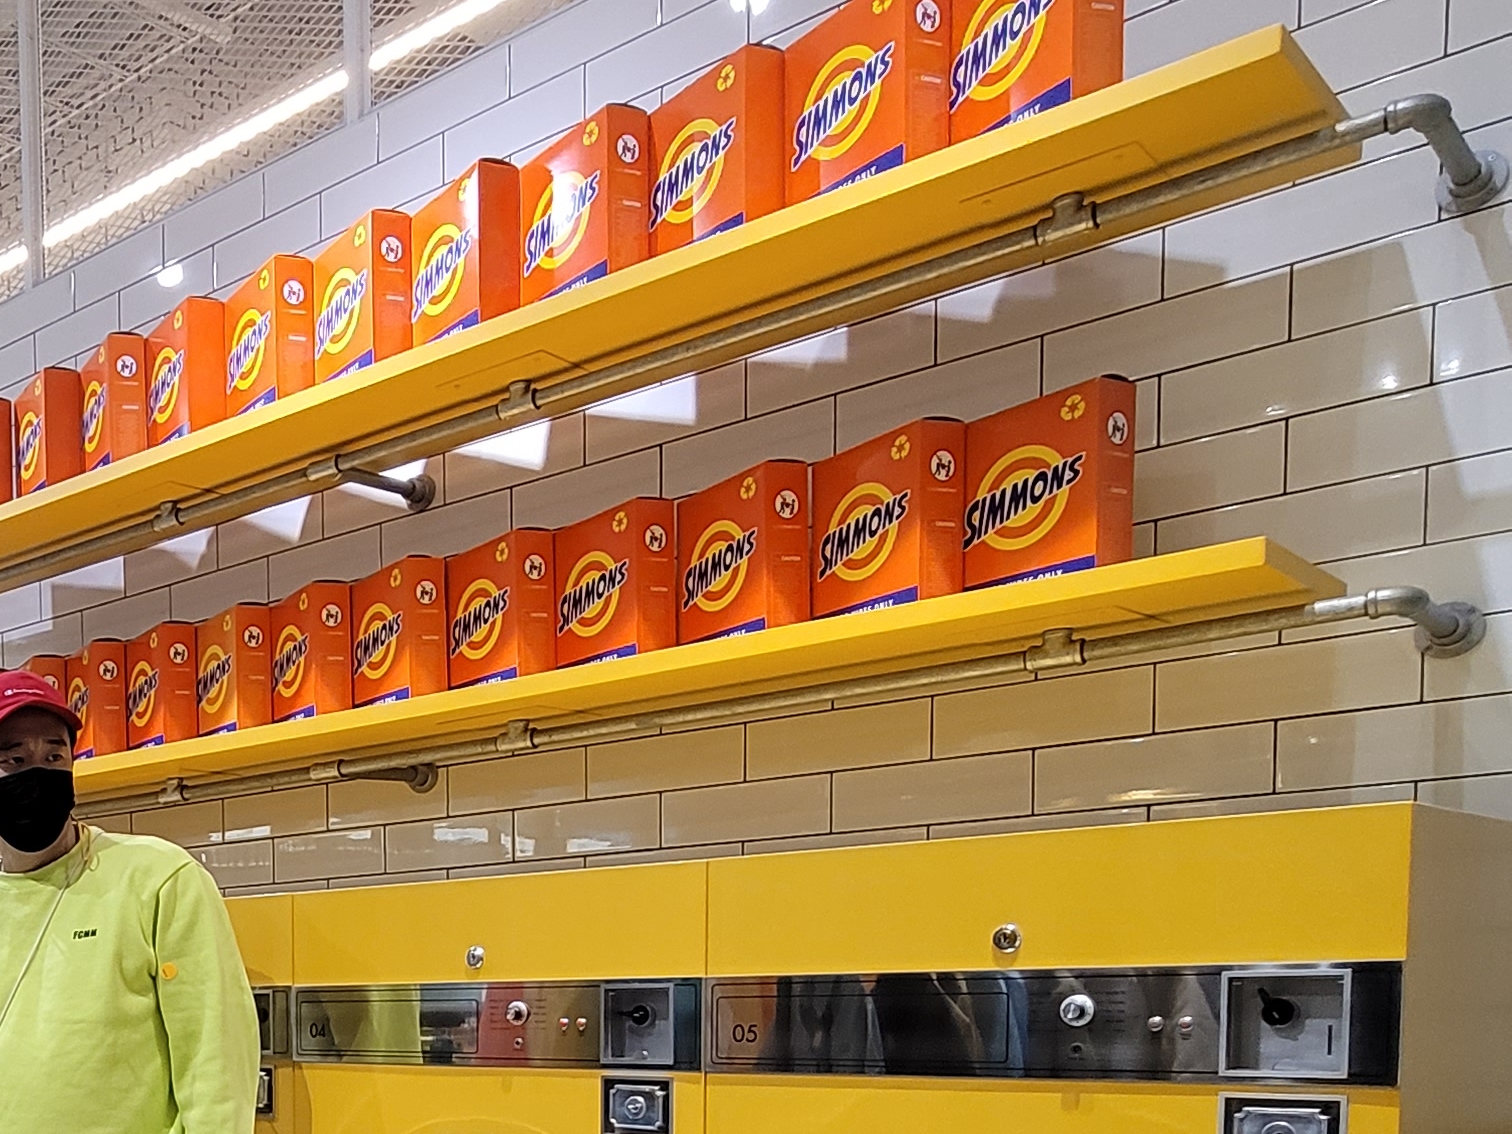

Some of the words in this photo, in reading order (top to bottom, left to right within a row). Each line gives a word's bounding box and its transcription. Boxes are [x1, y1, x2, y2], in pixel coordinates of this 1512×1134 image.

[791, 42, 894, 171] SIMMONS
[649, 117, 735, 232] SIMMONS
[525, 171, 599, 277] SIMONS
[316, 269, 367, 359] SIMMONS
[413, 227, 472, 322] SIMMONS
[149, 351, 184, 425] SIMMONS
[228, 311, 271, 394] SIMMONS
[818, 490, 910, 581] SIMMONS
[963, 452, 1085, 550] SIMMONS
[558, 559, 628, 636] SIMMONS
[683, 528, 757, 611] SIMMONS
[274, 634, 308, 693] SIMMONS
[355, 612, 401, 677] SIMMONS
[451, 587, 509, 658] SIMMONS
[197, 654, 231, 706] SIMMONS
[309, 1022, 326, 1039] 04
[732, 1023, 758, 1043] 05
